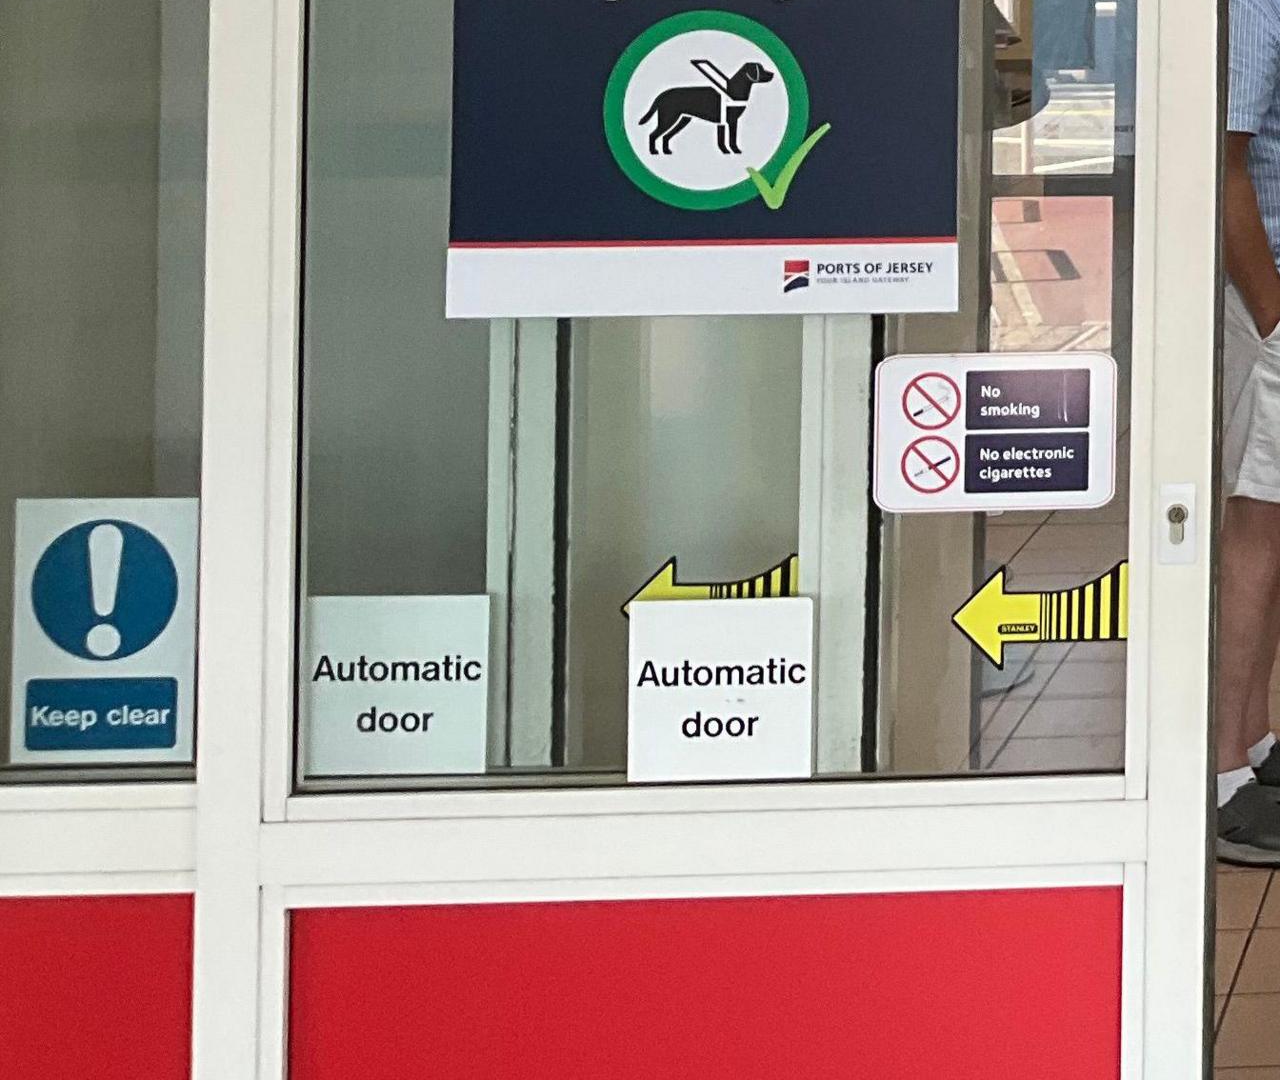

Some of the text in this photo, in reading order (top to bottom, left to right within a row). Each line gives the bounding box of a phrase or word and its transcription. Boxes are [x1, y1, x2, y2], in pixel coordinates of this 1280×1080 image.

[816, 261, 934, 275] PORTS OF JERSEY
[980, 385, 1001, 399] No
[980, 402, 1041, 420] smoking
[979, 445, 1075, 462] No electronic
[979, 464, 1052, 483] cigarettes
[1001, 624, 1036, 634] STANLEY
[312, 654, 483, 683] Automatic
[637, 658, 807, 688] Automatic
[30, 704, 171, 732] Keep clear
[356, 706, 434, 733] door
[681, 711, 760, 739] door
